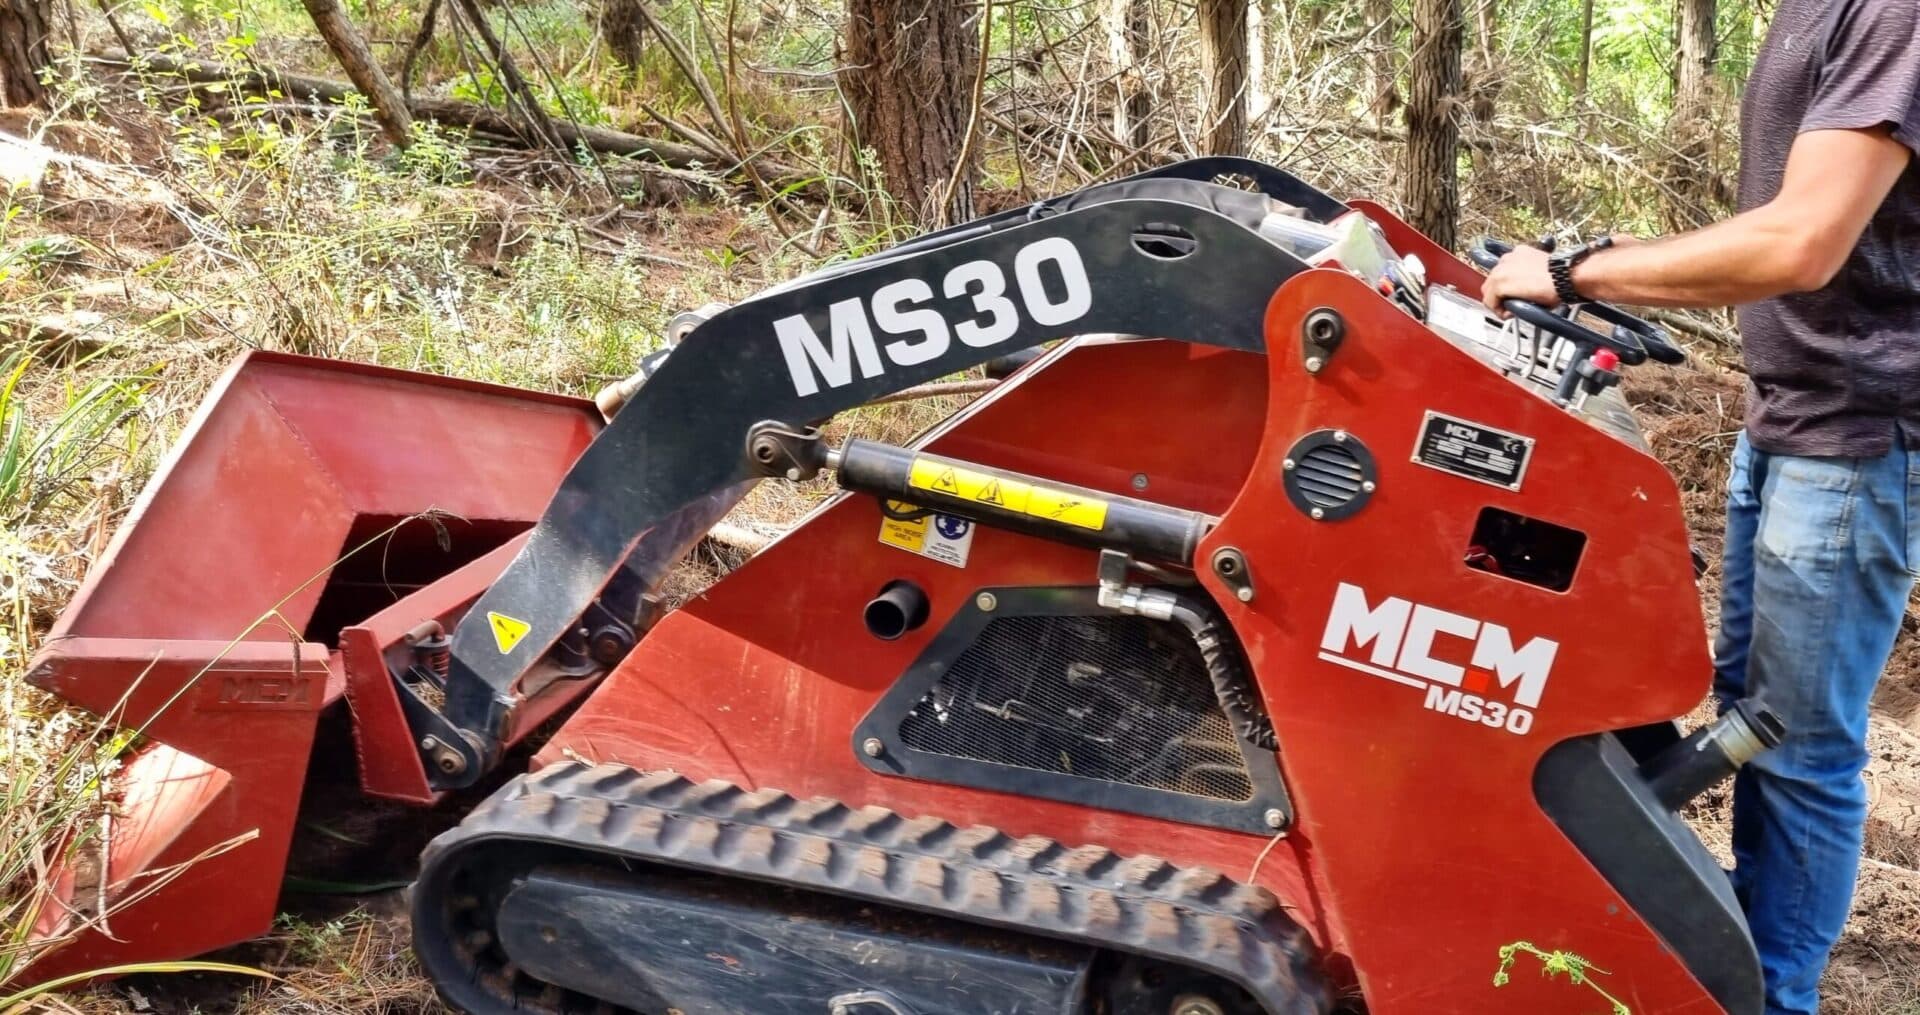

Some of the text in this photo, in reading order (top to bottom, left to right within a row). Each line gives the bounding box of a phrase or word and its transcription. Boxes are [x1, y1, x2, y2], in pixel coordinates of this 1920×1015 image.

[773, 237, 1092, 397] MS30
[1444, 423, 1479, 442] MCM
[1320, 581, 1559, 708] MCM
[218, 677, 310, 704] MCM
[1424, 684, 1534, 735] MS30
